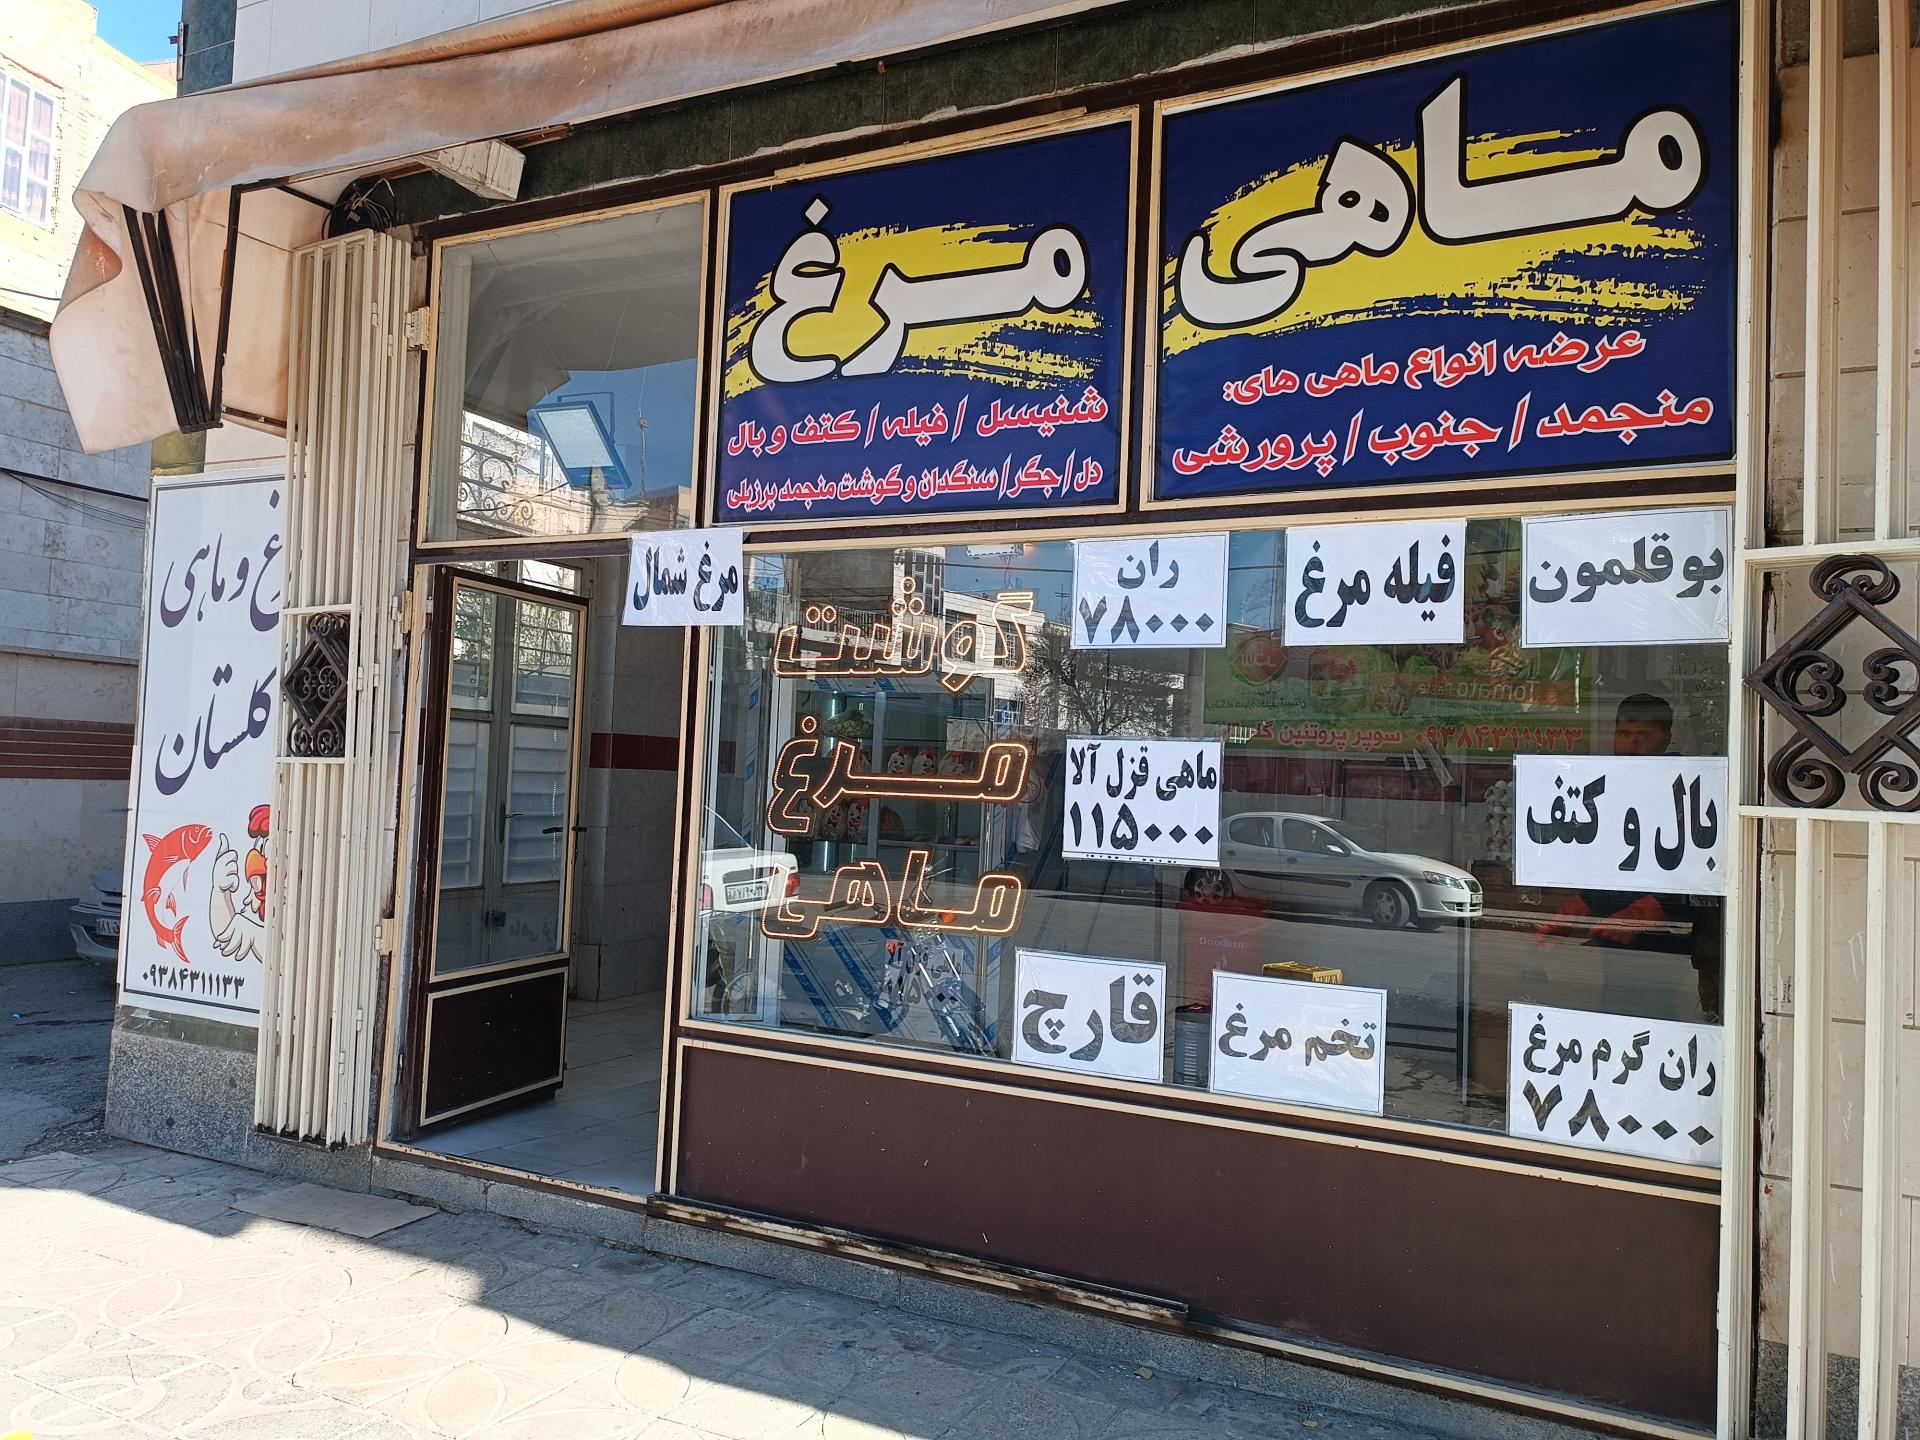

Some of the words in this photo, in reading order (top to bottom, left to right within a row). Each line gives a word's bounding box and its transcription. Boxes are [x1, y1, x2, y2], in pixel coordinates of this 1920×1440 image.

[1177, 72, 1711, 330] ماهی
[748, 193, 1092, 383] مرغ
[1304, 353, 1399, 397] ماهی
[1404, 338, 1497, 390] انواع
[1505, 328, 1648, 374] عرضه
[1223, 364, 1299, 405] های:
[791, 409, 861, 443] کتف
[883, 402, 949, 447] فیله
[977, 385, 1108, 438] شنیسل
[1368, 410, 1504, 458] جنوب
[1536, 388, 1716, 446] منجمد
[727, 421, 766, 458] بال
[765, 430, 787, 453] و
[1172, 423, 1338, 478] پرورشی
[726, 476, 781, 512] برزیلی
[779, 474, 836, 510] منجمد
[838, 464, 904, 505] گوشت
[902, 480, 916, 503] و
[919, 459, 997, 500] سنگدان
[1009, 455, 1061, 499] جگر
[1074, 456, 1103, 491] دل
[160, 532, 226, 628] ماهی
[228, 556, 250, 602] و
[633, 546, 687, 610] شمال
[693, 540, 738, 611] مرغ
[1117, 539, 1180, 589] ران
[1294, 540, 1371, 628] مرغ
[1383, 534, 1457, 621] فیله
[1529, 531, 1724, 603] بوقلمون
[772, 575, 1035, 693] گوشت
[1080, 595, 1215, 644] ۷۸۰۰۰
[1070, 743, 1101, 785] آلا
[1352, 730, 1401, 754] سوپر
[767, 716, 1029, 834] مرغ
[1106, 746, 1149, 800] قزل
[1156, 749, 1217, 801] ماهی
[1070, 801, 1213, 850] ۱۱۵۰۰۰
[1526, 774, 1606, 845] کتف
[1654, 773, 1717, 871] بال
[1618, 807, 1641, 871] و
[761, 849, 1024, 939] ماهی
[143, 964, 245, 999] ۰۹۳۸۴۳۱۱۱۳۳
[1020, 974, 1158, 1062] قارچ
[1219, 1003, 1292, 1061] مرغ
[1305, 1018, 1375, 1066] تخم
[1523, 1012, 1583, 1076] مرغ
[1592, 1030, 1650, 1085] گرم
[1659, 1034, 1716, 1097] ران
[1522, 1080, 1714, 1146] ۷۸۰۰۰
